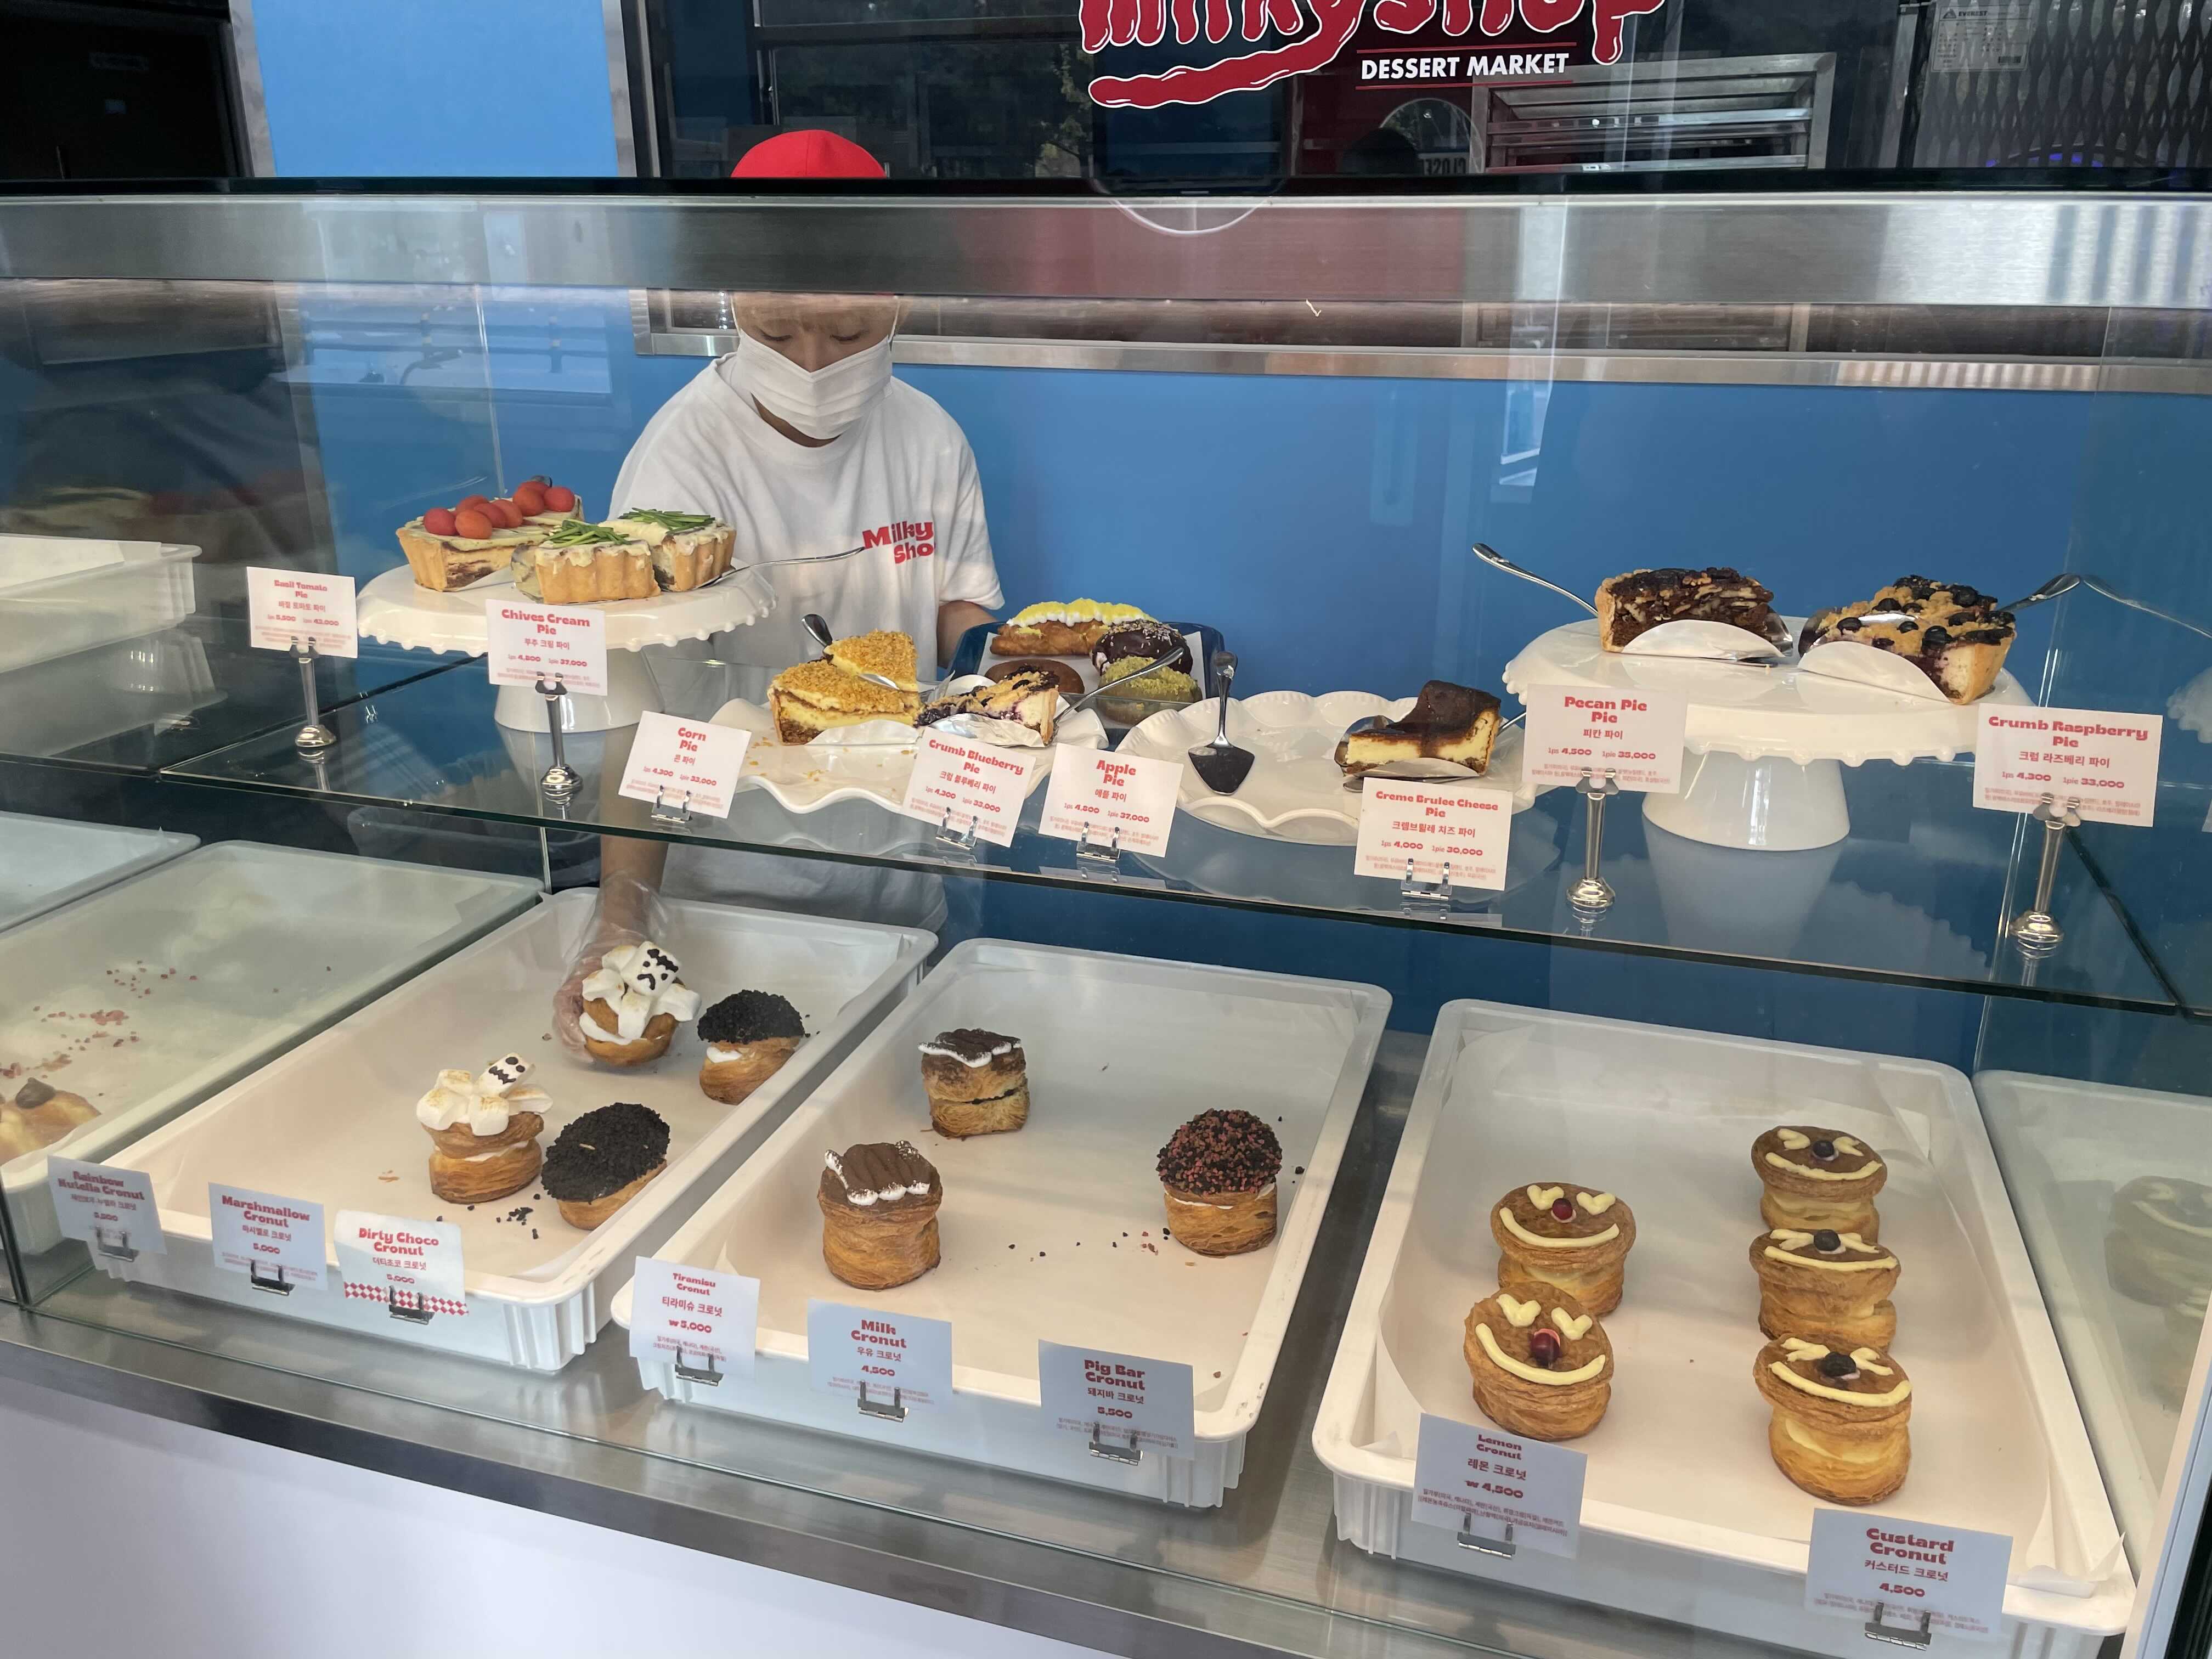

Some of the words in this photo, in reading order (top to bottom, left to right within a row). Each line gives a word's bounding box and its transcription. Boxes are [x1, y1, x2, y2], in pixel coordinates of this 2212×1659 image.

[1362, 57, 1460, 80] DESSERT
[1467, 53, 1569, 76] MARKET
[862, 521, 934, 549] Milky
[894, 543, 936, 564] Sho
[296, 582, 327, 591] Tomato
[501, 609, 544, 622] Chives
[548, 614, 590, 627] Cream
[537, 624, 556, 634] Pie
[541, 640, 554, 648] 크림
[557, 641, 569, 650] 파이
[1565, 697, 1616, 709] Pecan
[1621, 699, 1647, 711] Pie
[1592, 712, 1617, 723] Pie
[678, 727, 707, 741] Corn
[1583, 729, 1601, 738] 피칸
[1605, 730, 1623, 740] 파이
[1988, 716, 2049, 730] Crumb
[2052, 721, 2148, 741] Raspberry
[680, 740, 698, 752] Pie
[2053, 736, 2079, 747] Pie
[682, 756, 696, 765] 파이
[929, 740, 966, 757] Crumb
[968, 750, 1024, 775] Blueberry
[2019, 751, 2039, 762] 크럼
[2043, 753, 2085, 766] 라즈베리
[2089, 757, 2109, 768] 파이
[963, 762, 980, 774] Pie
[1096, 760, 1137, 775] Apple
[940, 771, 953, 781] 크럼
[955, 775, 980, 790] 블루베리
[983, 783, 996, 794] 파이
[1103, 774, 1124, 786] Pie
[2081, 778, 2124, 788] 33,000
[1095, 789, 1109, 799] 애플
[1111, 792, 1127, 802] 파이
[1376, 791, 1413, 802] Creme
[1416, 795, 1454, 806] Brulee
[1457, 799, 1498, 810] Cheese
[1120, 812, 1149, 823] 37,000
[1425, 807, 1446, 817] Pie
[1438, 826, 1455, 835] 치즈
[1459, 827, 1475, 837] 파이
[1447, 847, 1483, 856] 30,000
[73, 1171, 123, 1187] Rainbow
[58, 1178, 100, 1193] Nutella
[102, 1186, 145, 1200] Cronut
[222, 1195, 310, 1221] Marshmallow
[244, 1211, 289, 1228] Cronut
[271, 1231, 291, 1242] 크로넛
[359, 1228, 393, 1244] Dirty
[397, 1232, 439, 1246] Choco
[374, 1242, 424, 1256] Cronut
[373, 1257, 402, 1268] 더티초코
[404, 1261, 426, 1271] 크로넛
[673, 1273, 716, 1288] Tiramisu
[676, 1283, 710, 1295] Cronut
[662, 1296, 695, 1312] 티라미슈
[698, 1304, 722, 1317] 크로넛
[681, 1321, 712, 1333] 5,000
[861, 1319, 896, 1335] Milk
[851, 1330, 907, 1348] Cronut
[857, 1346, 873, 1357] 우유
[877, 1351, 901, 1362] 크로넛
[861, 1365, 895, 1376] 4,500
[1084, 1359, 1111, 1375] Pig
[1115, 1364, 1146, 1378] Bar
[1085, 1372, 1146, 1390] Cronut
[1088, 1387, 1114, 1400] 돼지바
[1118, 1393, 1144, 1404] 크로넛
[1098, 1407, 1133, 1418] 5,500
[1479, 1434, 1522, 1451] Lemon
[1476, 1444, 1521, 1460] Cronut
[1468, 1458, 1489, 1472] 레몬
[1493, 1464, 1526, 1481] 크로넛
[1482, 1483, 1523, 1498] 4,500
[1866, 1528, 1954, 1552] Custard
[1870, 1542, 1947, 1565] Cronut
[1865, 1560, 1909, 1575] 커스터드
[1914, 1568, 1948, 1582] 크로넛
[1880, 1583, 1925, 1598] 4,500
